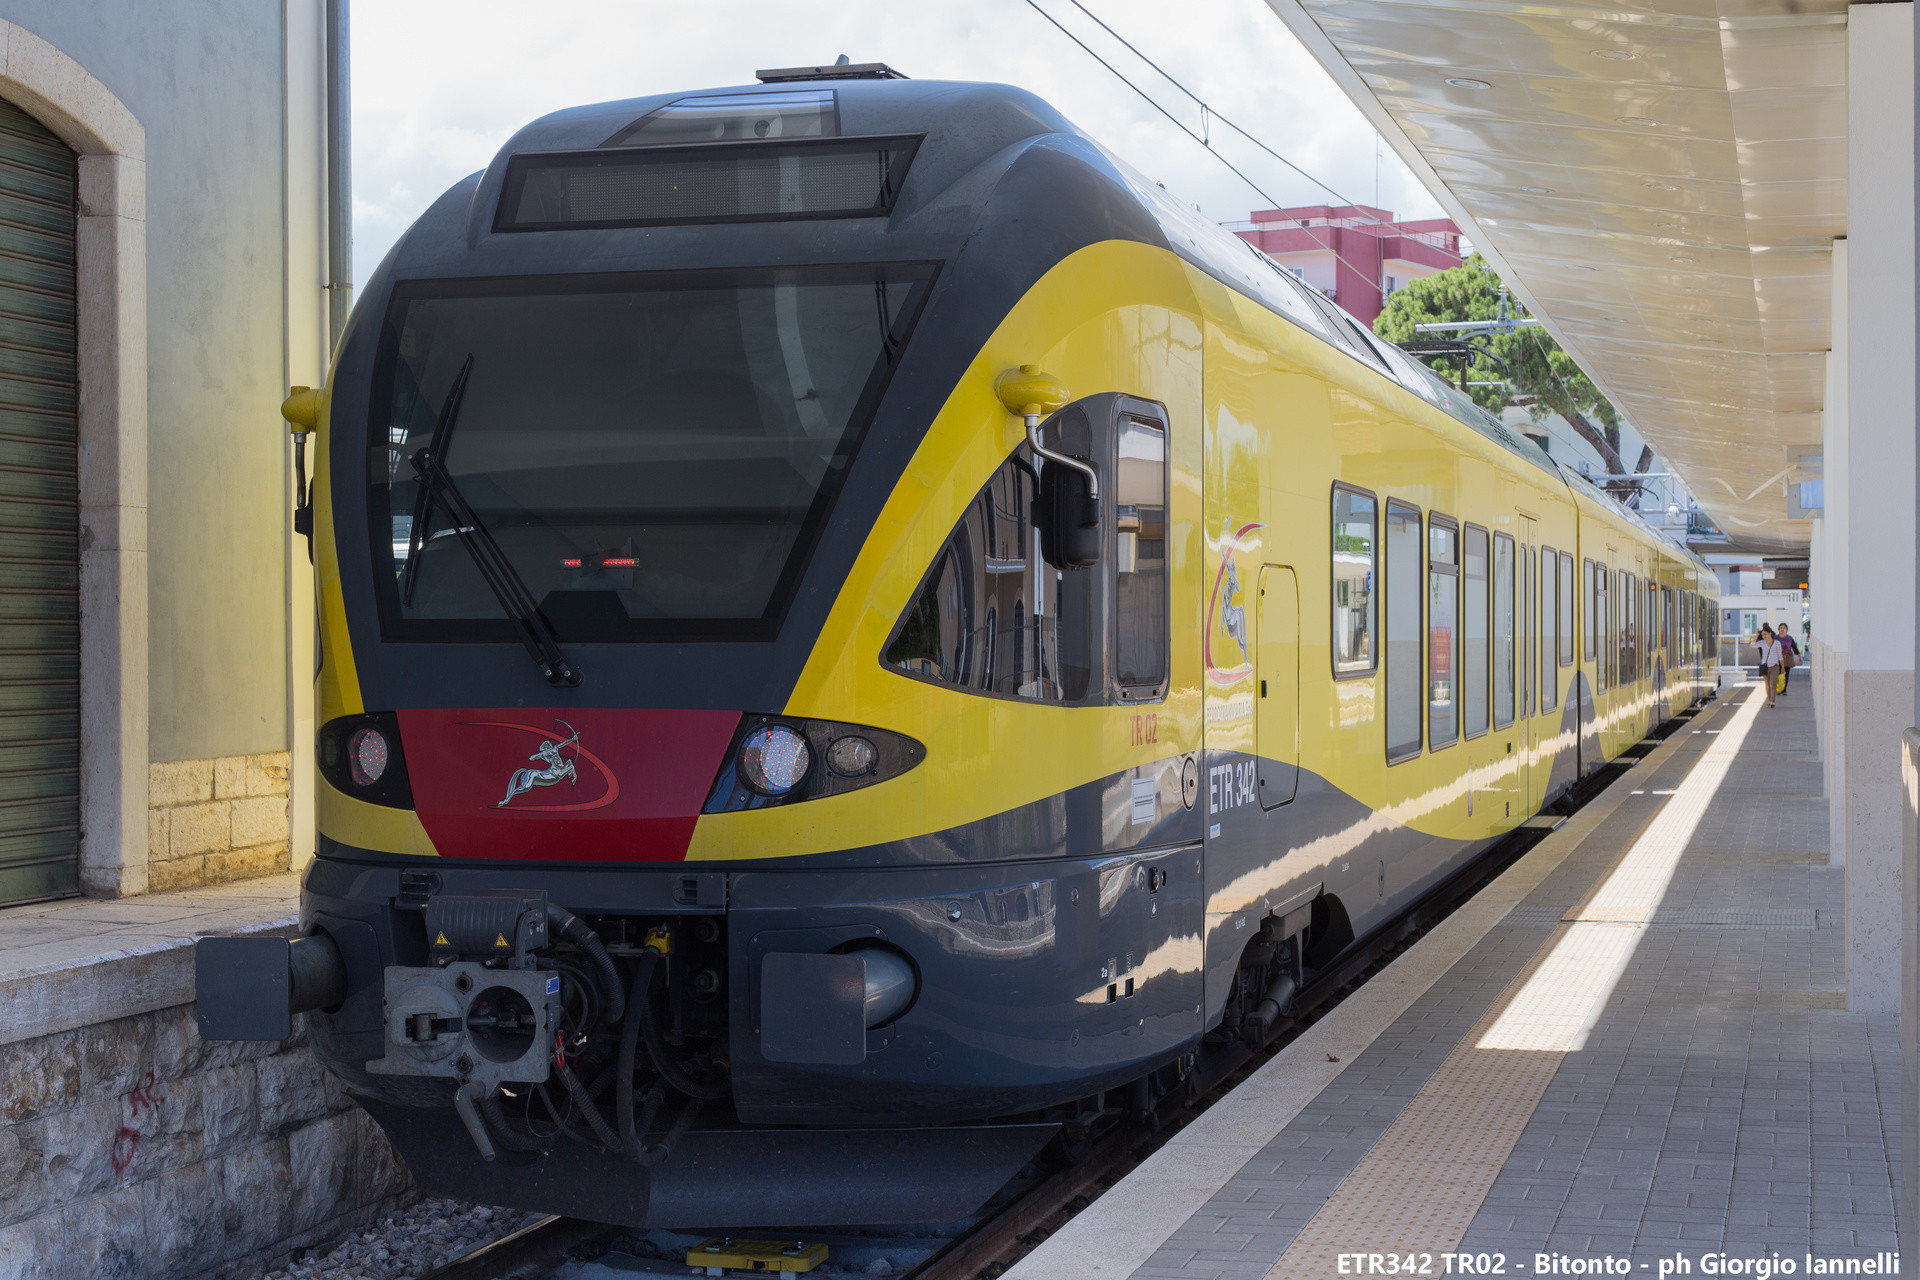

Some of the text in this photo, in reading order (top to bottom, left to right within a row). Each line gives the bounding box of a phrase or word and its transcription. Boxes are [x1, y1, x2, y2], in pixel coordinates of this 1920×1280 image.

[1130, 713, 1158, 746] TR 02
[1210, 763, 1233, 815] ETR
[1236, 760, 1255, 807] 342
